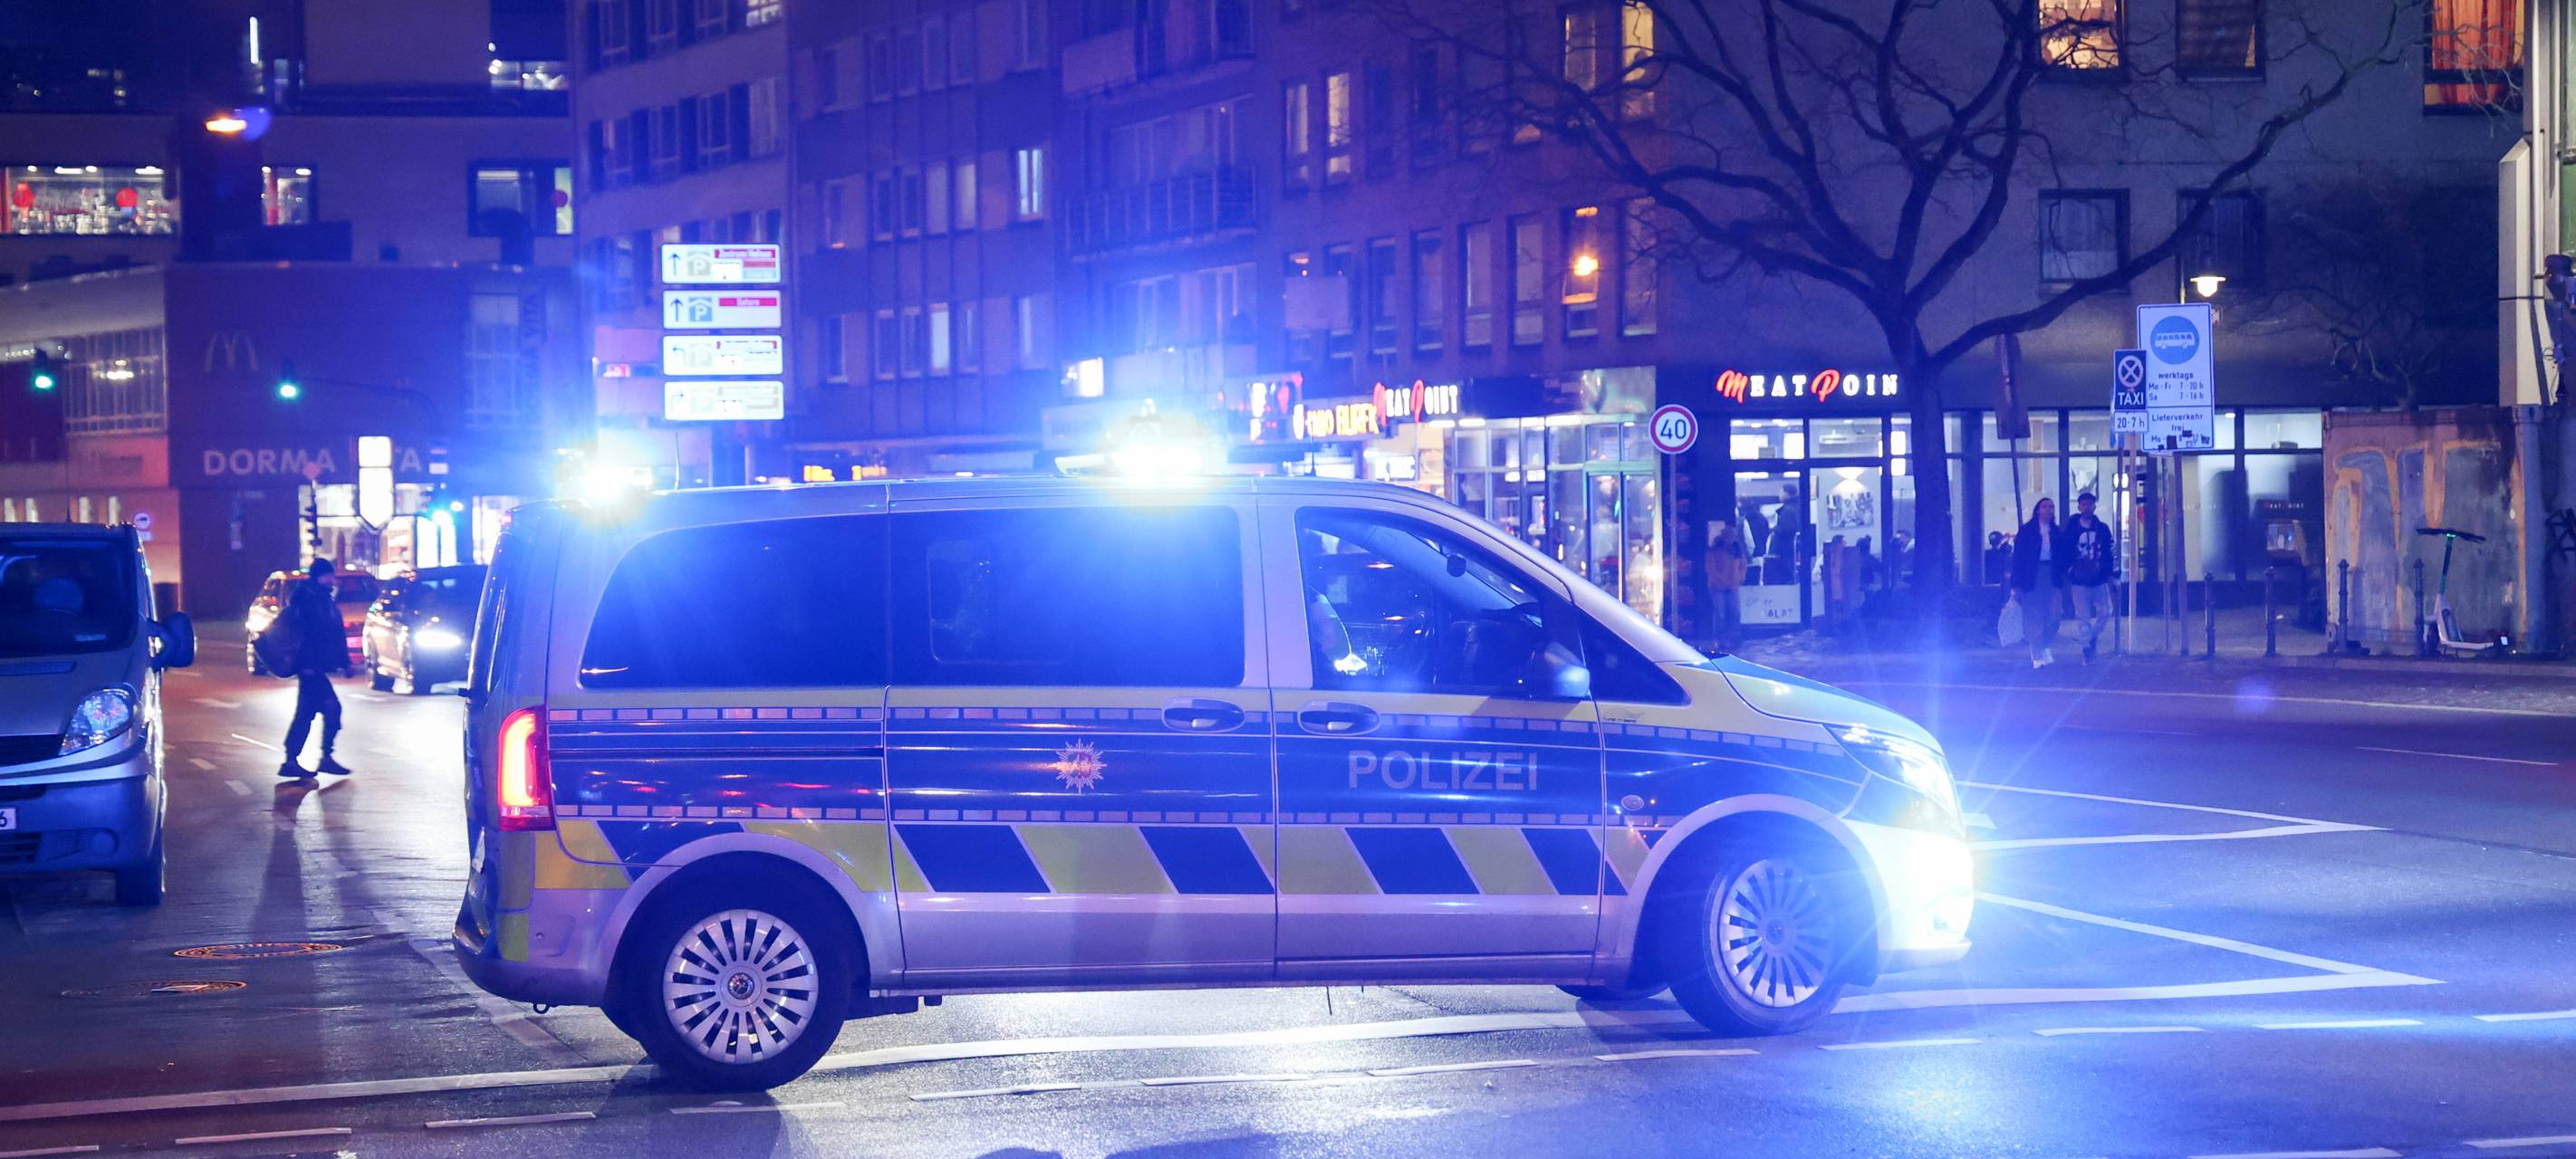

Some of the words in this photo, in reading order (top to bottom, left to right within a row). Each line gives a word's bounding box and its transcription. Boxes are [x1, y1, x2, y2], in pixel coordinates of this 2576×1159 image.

[2158, 371, 2194, 380] werktags
[1715, 369, 1807, 403] MEAT
[1811, 369, 1898, 403] POIN
[2118, 392, 2144, 406] TAXI
[2148, 392, 2158, 400] Sa
[2139, 417, 2145, 427] h
[2151, 413, 2203, 422] Lieferverkehr
[1660, 419, 1687, 439] 40
[2171, 423, 2185, 432] frei
[204, 449, 335, 475] DORMA
[1349, 751, 1537, 790] POLIZEI
